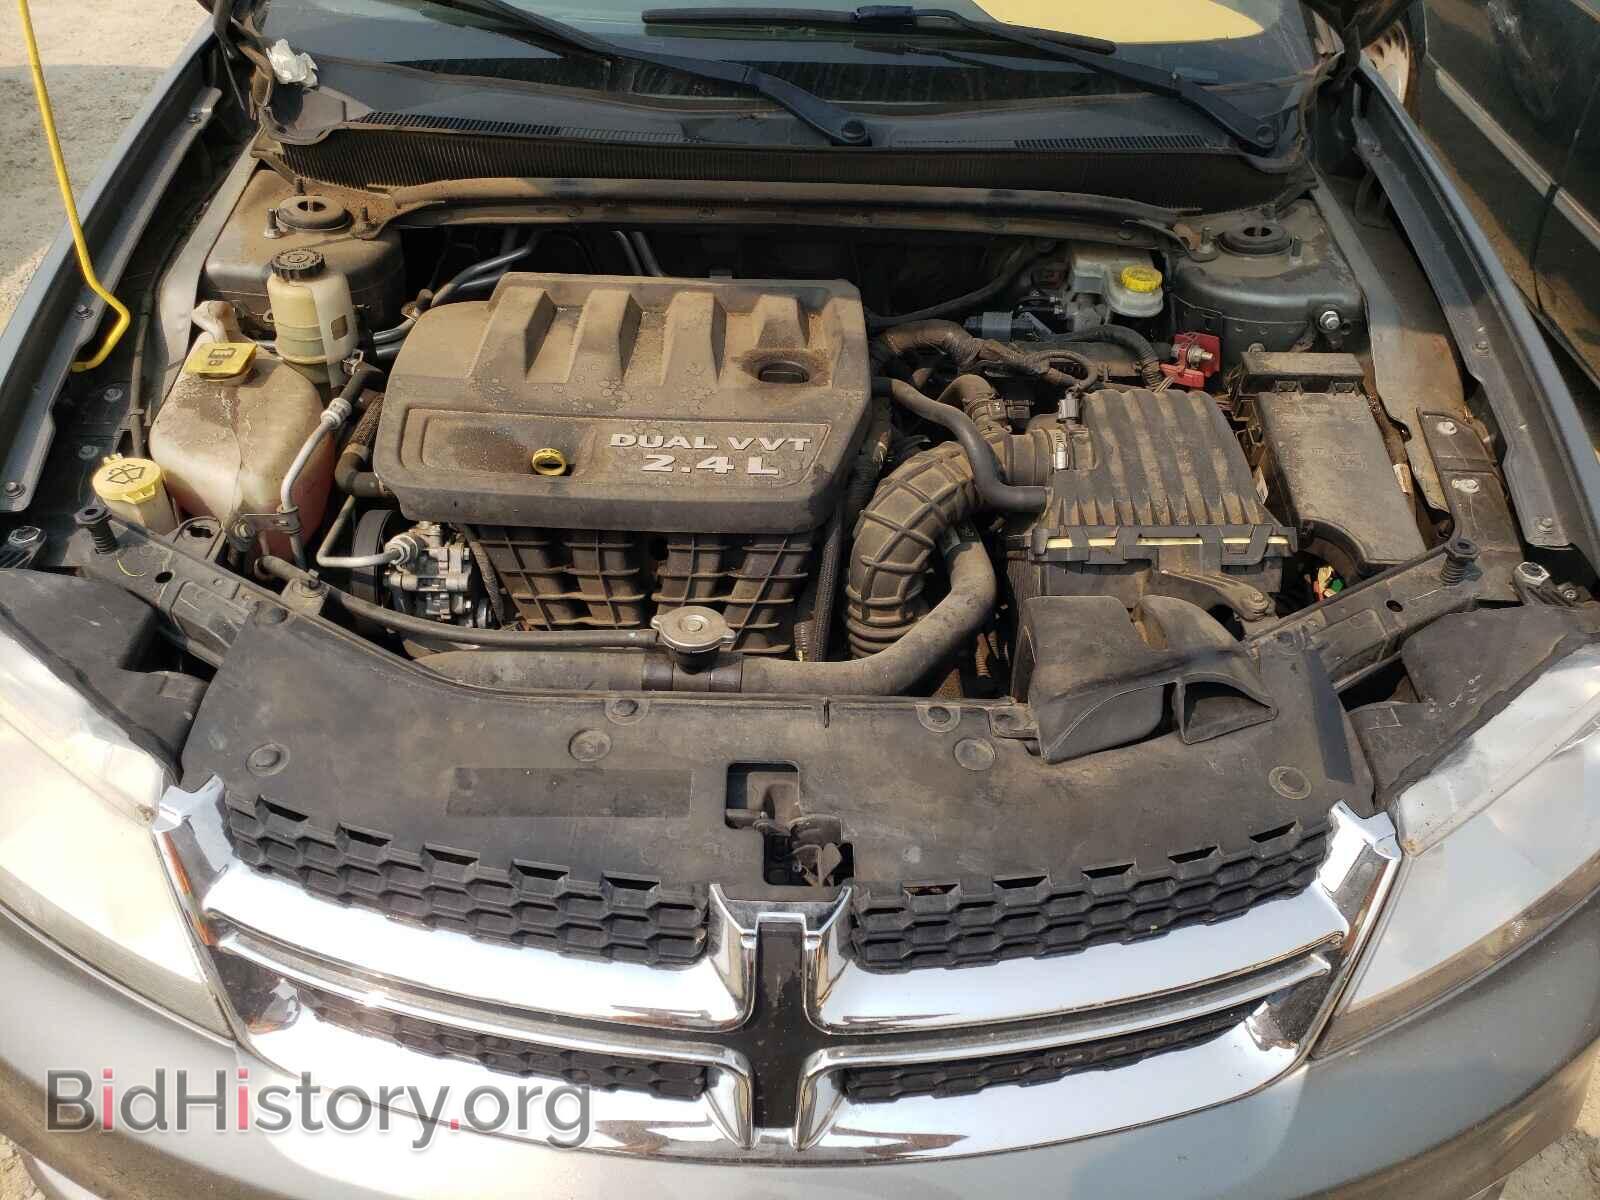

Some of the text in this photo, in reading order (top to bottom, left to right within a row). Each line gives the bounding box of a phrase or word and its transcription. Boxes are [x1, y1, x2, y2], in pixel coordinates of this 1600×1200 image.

[608, 433, 812, 451] DUAL VVT
[642, 454, 779, 476] 2.4 L
